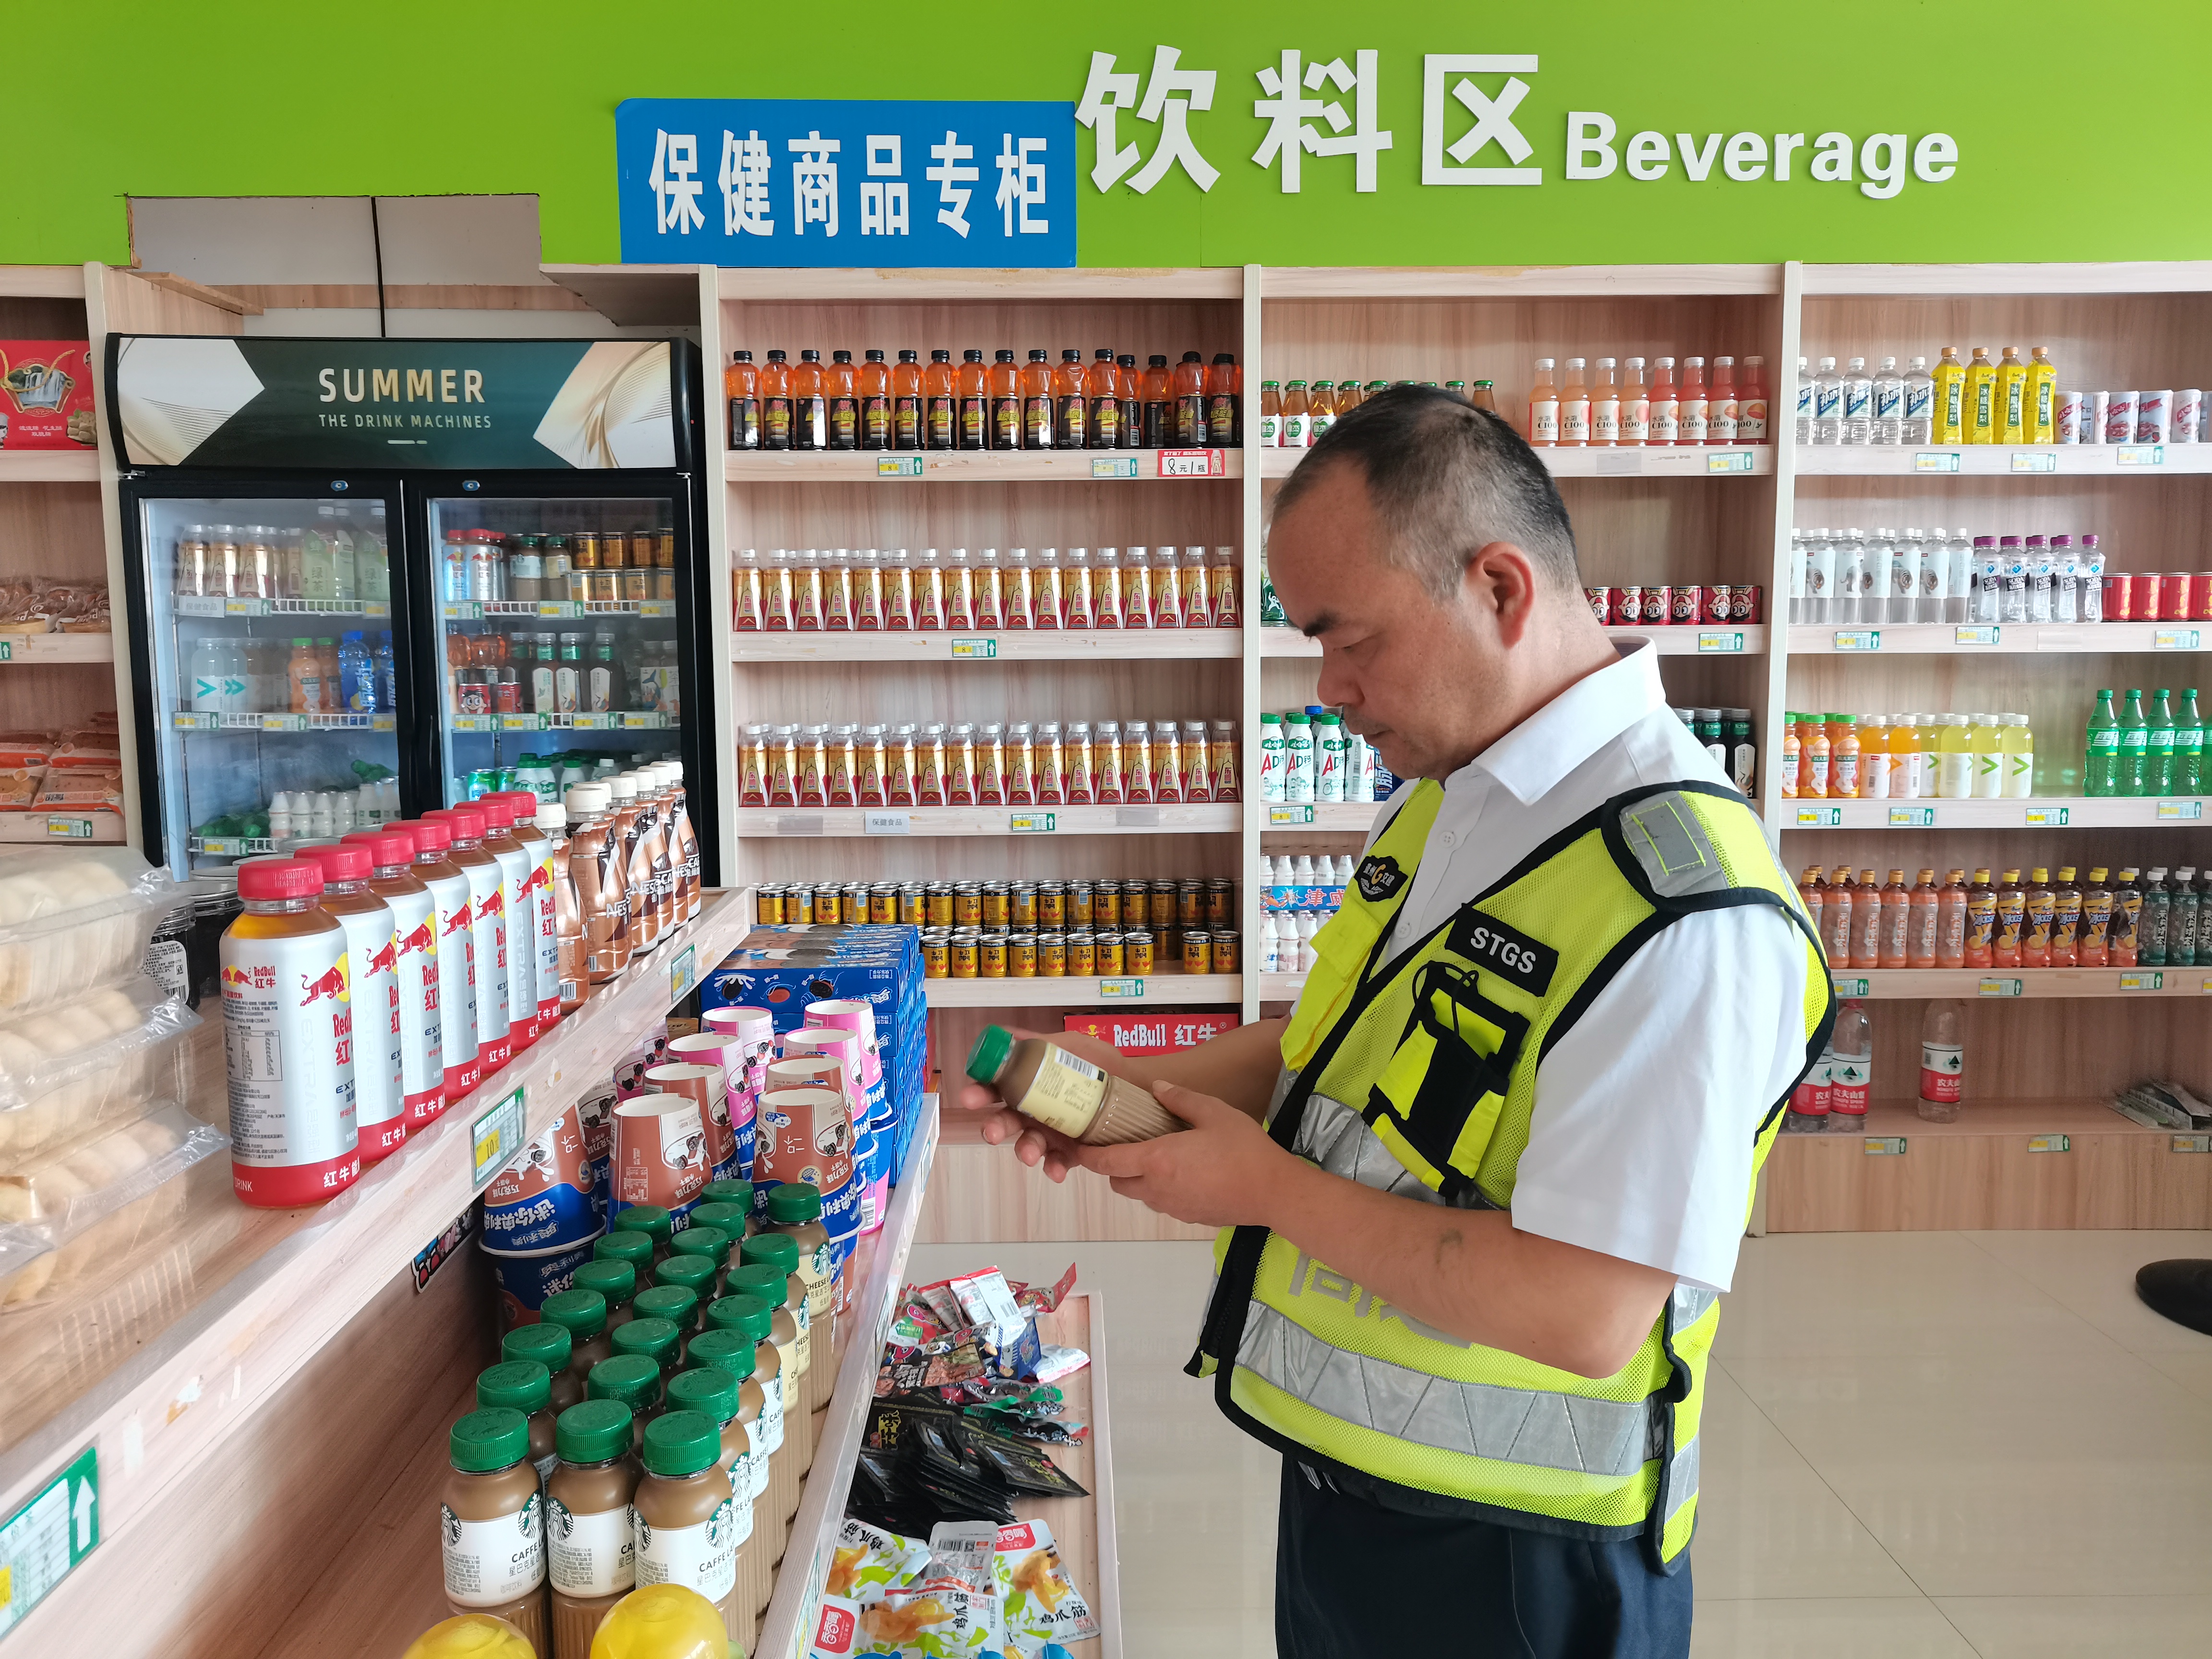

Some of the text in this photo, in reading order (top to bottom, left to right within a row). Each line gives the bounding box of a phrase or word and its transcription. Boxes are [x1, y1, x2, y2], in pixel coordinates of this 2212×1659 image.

[1075, 45, 1542, 193] 饮料区
[1566, 111, 1958, 200] Beverage
[649, 128, 1049, 239] 保健商品专柜
[319, 368, 485, 403] SUMMER
[319, 414, 491, 428] THE DRINK MACHINES
[1564, 421, 1584, 429] C100
[1597, 420, 1617, 428] C100
[1620, 420, 1640, 428] C100
[1652, 421, 1672, 429] C100
[1738, 420, 1751, 428] 100
[1470, 926, 1536, 974] STGS
[254, 965, 276, 977] RedBull
[254, 978, 276, 989] 红牛
[424, 989, 438, 1011] 红
[425, 1025, 441, 1036] EXT
[1113, 1023, 1166, 1048] RedBull
[1174, 1022, 1218, 1046] 红牛
[336, 1039, 350, 1066] 红
[336, 1079, 355, 1094] EXT
[461, 1070, 480, 1086] 红牛
[1937, 1078, 1960, 1087] 农夫山
[414, 1096, 445, 1118] 红牛能
[486, 1138, 495, 1160] 10
[784, 1135, 803, 1145] 一个
[787, 1145, 805, 1154] 一口
[323, 1155, 360, 1188] 红牛能
[674, 1176, 703, 1198] 巧克力味
[844, 1518, 885, 1551] 鸡爪筋
[512, 1542, 538, 1563] CAFFE
[621, 1540, 635, 1555] CA
[509, 1551, 546, 1577] 星巴克星选
[699, 1551, 726, 1572] CAFFE
[953, 1591, 970, 1630] 鸡爪筋
[1039, 1604, 1088, 1626] 鸡爪筋
